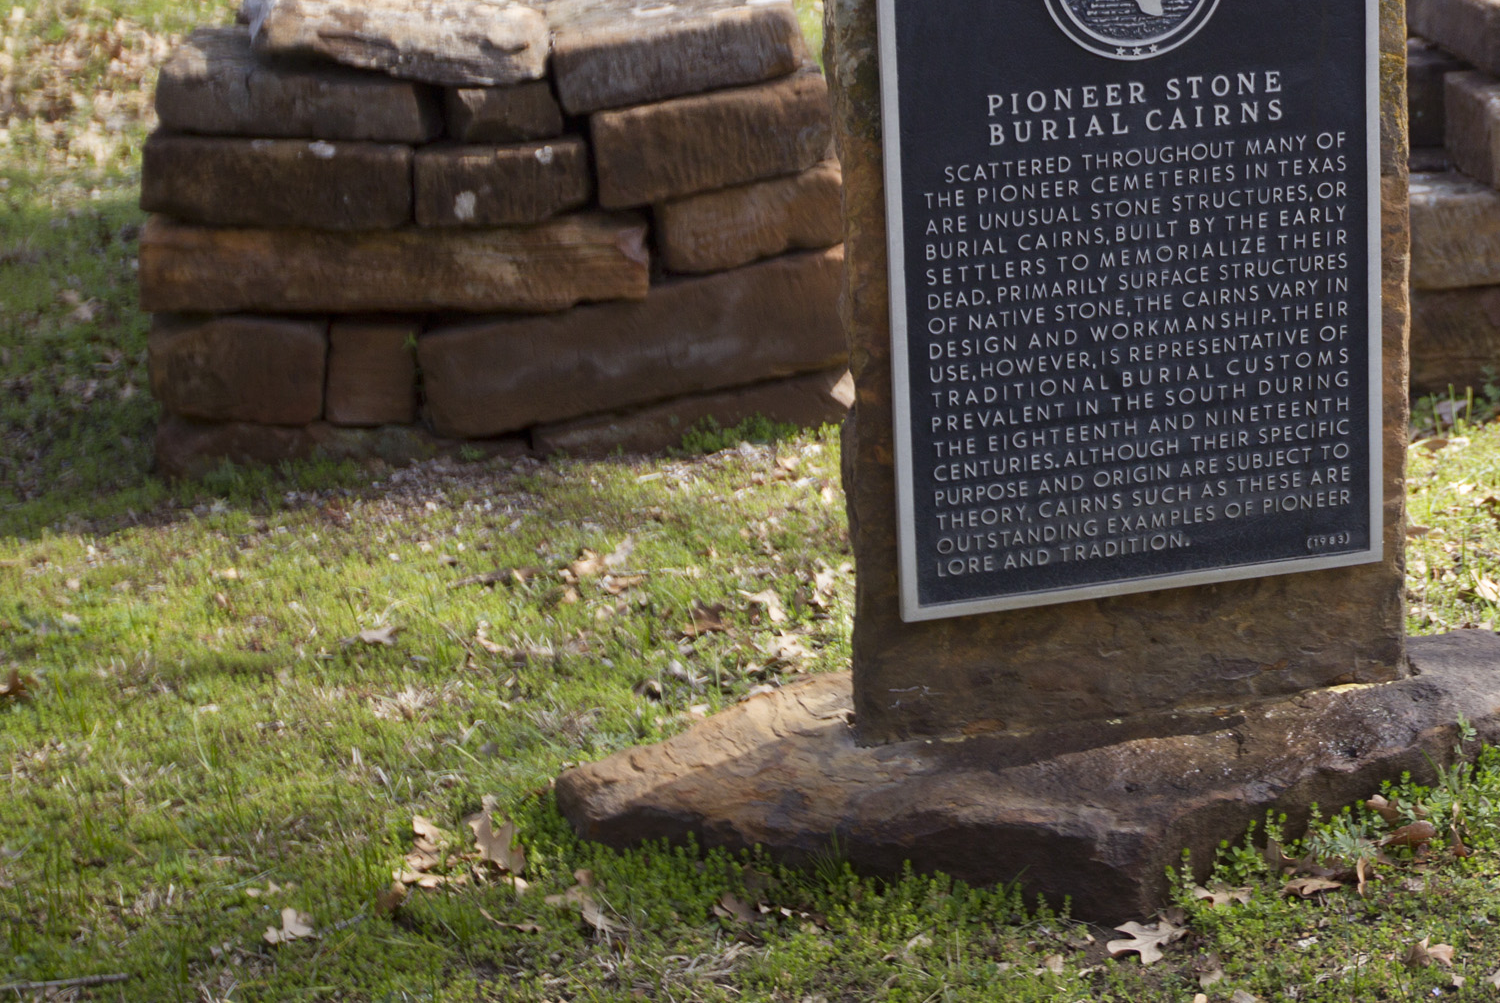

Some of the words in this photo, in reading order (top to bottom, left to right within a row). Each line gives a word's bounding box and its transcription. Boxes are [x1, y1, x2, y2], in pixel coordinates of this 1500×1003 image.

[986, 80, 1147, 117] PIONEER
[1165, 69, 1282, 101] STONE
[987, 111, 1129, 147] BURIAL
[1144, 97, 1283, 132] CAIRNS
[923, 188, 965, 210] THE
[976, 178, 1079, 205] PIONEER
[1090, 163, 1236, 194] CEMETERIES
[1245, 161, 1268, 180] IN
[1277, 154, 1347, 177] TEXAS
[943, 155, 1072, 184] SCATTERED
[1080, 139, 1236, 171] THROUGHOUT
[1244, 133, 1308, 156] MANY
[1315, 130, 1347, 150] OF
[925, 214, 968, 236] ARE
[978, 205, 1082, 231] UNUSUAL
[1090, 196, 1161, 220] STONE
[1171, 183, 1314, 213] STRUCTURES,
[1316, 180, 1347, 200] OR
[925, 236, 1008, 262] BURIAL
[1017, 226, 1111, 252] CAIRNS,
[1115, 219, 1179, 243] BUILT
[1188, 215, 1216, 236] BY
[1224, 211, 1269, 232] THE
[1279, 204, 1347, 227] EARLY
[925, 257, 1047, 287] SETTLERS
[1056, 253, 1090, 273] TO
[1099, 234, 1267, 269] MEMORIALIZE
[1277, 228, 1348, 251] THEIR
[927, 288, 992, 311] DEAD.
[996, 274, 1108, 304] PRIMARILY
[1117, 265, 1210, 291] SURFACE
[1218, 251, 1349, 281] STRUCTURES
[927, 315, 958, 336] OF
[967, 306, 1046, 331] NATIVE
[1053, 297, 1132, 322] STONE,
[1133, 293, 1173, 313] THE
[1181, 284, 1260, 308] CAIRNS
[1266, 278, 1319, 300] VARY
[1327, 276, 1349, 294] IN
[928, 334, 1017, 361] DESIGN
[1027, 328, 1078, 350] AND
[1089, 307, 1277, 343] WORKMANSHIP.
[1280, 299, 1348, 322] THEIR
[929, 363, 977, 384] USE,
[980, 350, 1097, 379] HOWEVER,
[1100, 347, 1121, 366] IS
[1128, 327, 1310, 363] REPRESENTATIVE
[1318, 323, 1348, 342] OF
[930, 373, 1110, 408] TRADITIONAL
[1121, 362, 1215, 388] BURIAL
[1225, 346, 1350, 376] CUSTOMS
[931, 402, 1065, 433] PREVALENT
[1076, 398, 1099, 417] IN
[1110, 391, 1154, 413] THE
[1164, 382, 1246, 407] SOUTH
[1258, 369, 1350, 396] DURING
[932, 437, 976, 458] THE
[987, 419, 1138, 452] EIGHTEENTH
[1147, 412, 1196, 434] AND
[1205, 395, 1350, 427] NINETEENTH
[933, 451, 1061, 482] CENTURIES.
[1063, 437, 1180, 467] ALTHOUGH
[1189, 429, 1249, 452] THEIR
[1258, 417, 1350, 445] SPECIFIC
[934, 480, 1029, 507] PURPOSE
[1037, 474, 1085, 495] AND
[1092, 462, 1171, 488] ORIGIN
[1179, 457, 1218, 478] ARE
[1225, 446, 1313, 472] SUBJECT
[1320, 441, 1350, 460] TO
[935, 504, 1032, 531] THEORY,
[1038, 492, 1123, 518] CAIRNS
[1131, 485, 1192, 507] SUCH
[1200, 479, 1228, 499] AS
[1236, 470, 1302, 494] THESE
[1310, 465, 1351, 486] ARE
[936, 518, 1099, 554] OUTSTANDING
[1107, 504, 1216, 534] EXAMPLES
[1224, 500, 1254, 519] OF
[1262, 488, 1351, 514] PIONEER
[936, 554, 994, 578] LORE
[1003, 548, 1051, 570] AND
[1059, 532, 1191, 563] TRADITION.
[1306, 531, 1351, 549] (1983)
